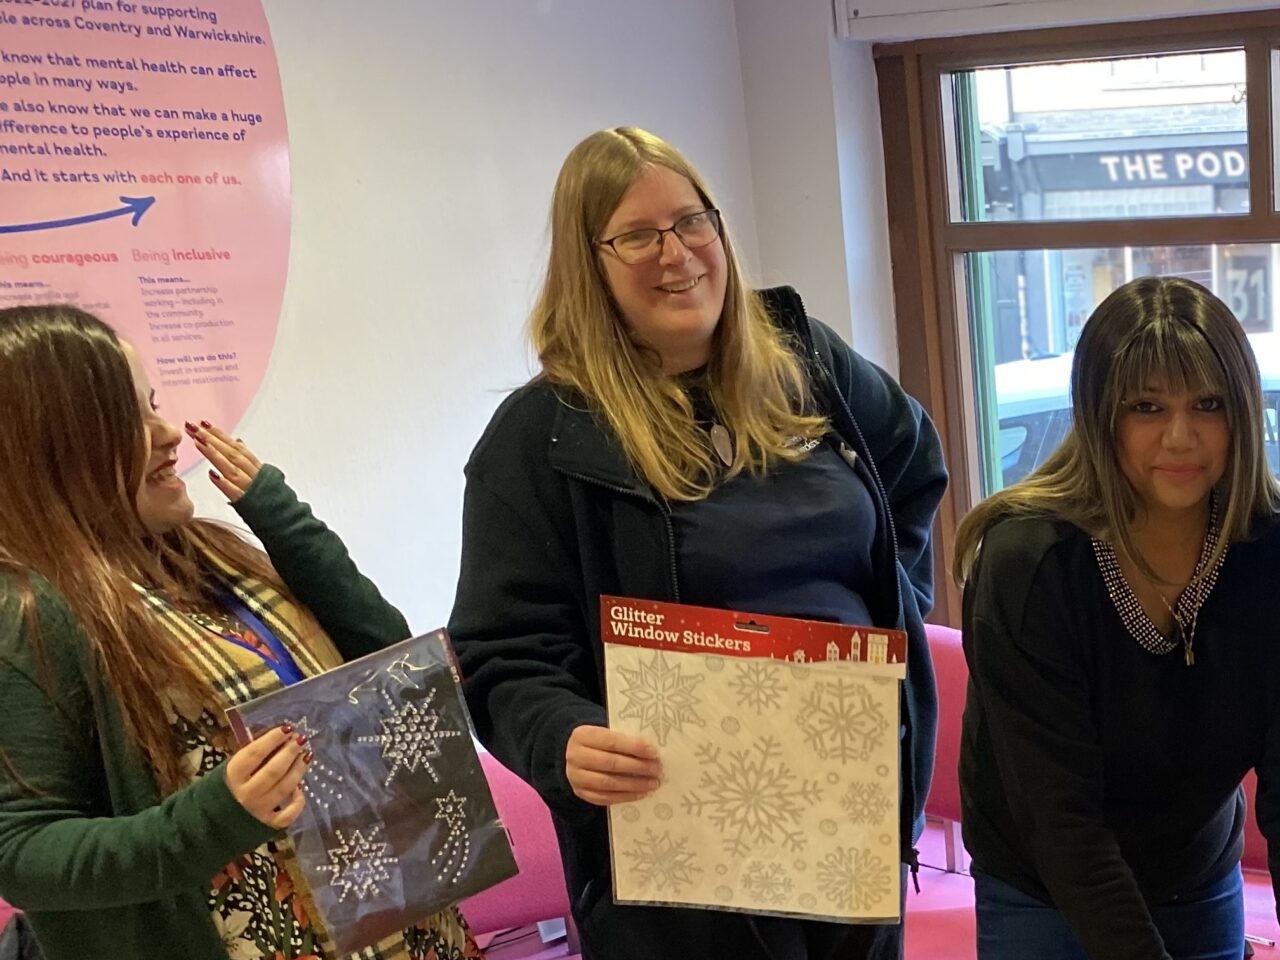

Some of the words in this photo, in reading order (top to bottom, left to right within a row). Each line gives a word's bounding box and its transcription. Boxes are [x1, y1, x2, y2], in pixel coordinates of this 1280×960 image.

[81, 0, 113, 13] plan
[117, 0, 138, 13] for
[141, 5, 218, 25] supporting
[22, 15, 71, 29] across
[74, 16, 141, 38] Coventry
[147, 25, 172, 37] and
[174, 25, 266, 45] Warwickshire.
[1, 50, 42, 65] know
[47, 51, 81, 67] that
[86, 58, 139, 71] mental
[141, 58, 187, 75] health
[190, 65, 214, 76] can
[217, 64, 257, 79] affect
[34, 73, 49, 86] in
[53, 77, 92, 92] many
[97, 80, 138, 94] ways.
[13, 99, 45, 113] also
[48, 100, 88, 115] know
[93, 103, 126, 117] that
[130, 108, 150, 118] we
[154, 108, 179, 120] can
[182, 108, 217, 121] make
[221, 112, 228, 121] a
[231, 109, 263, 126] huge
[71, 123, 89, 135] to
[93, 125, 153, 140] people's
[156, 126, 229, 142] experience
[233, 129, 247, 141] of
[53, 142, 108, 157] health.
[1, 169, 32, 182] And
[35, 169, 48, 182] it
[52, 171, 100, 182] starts
[103, 170, 138, 183] with
[140, 171, 173, 184] each
[176, 174, 202, 184] one
[205, 171, 218, 184] of
[222, 175, 243, 185] us.
[1100, 153, 1168, 182] THE
[1175, 150, 1246, 179] POD
[31, 252, 119, 267] courageous
[131, 248, 170, 265] Being
[1226, 269, 1265, 322] 31
[610, 606, 665, 626] Glitter
[610, 621, 679, 643] Window
[683, 630, 751, 652] Stickers
